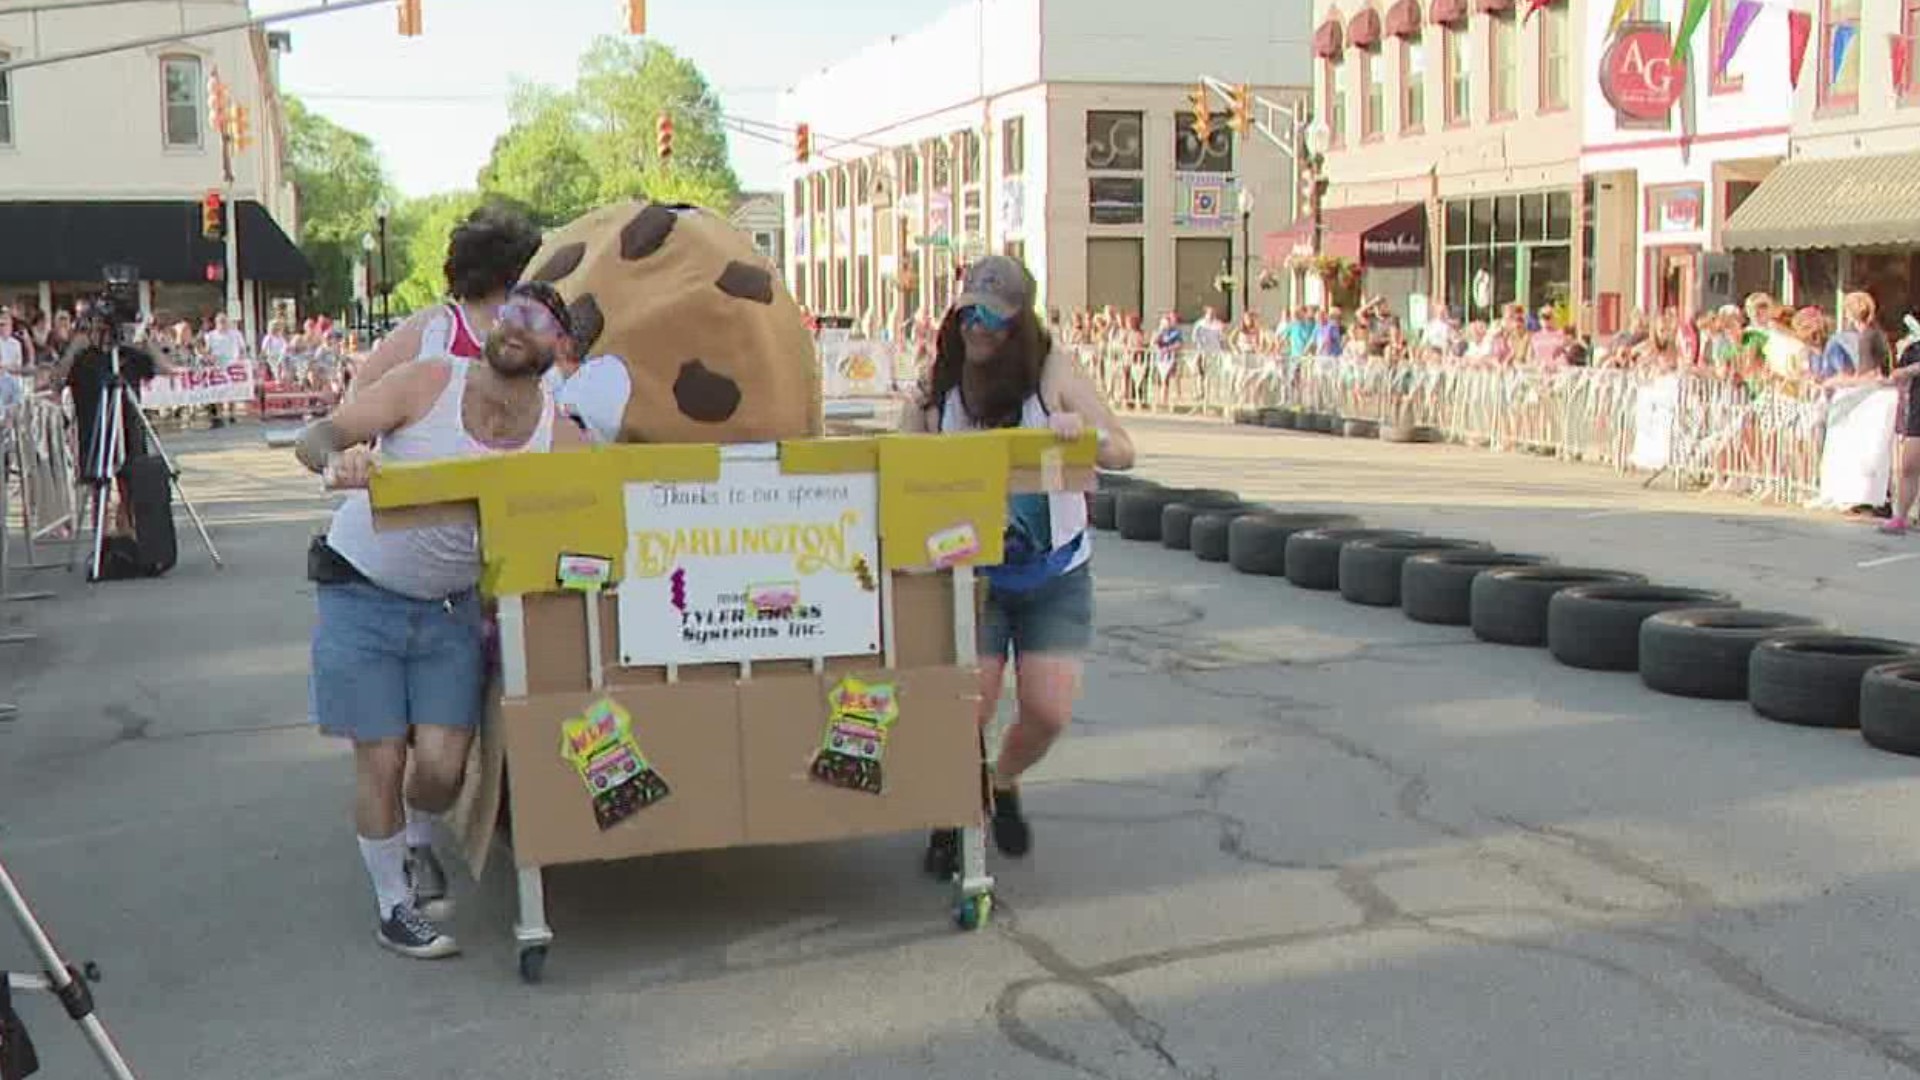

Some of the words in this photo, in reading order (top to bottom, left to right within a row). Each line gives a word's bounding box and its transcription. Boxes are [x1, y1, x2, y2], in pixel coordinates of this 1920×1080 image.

[1620, 39, 1673, 93] AG
[653, 479, 719, 506] Thanks
[729, 486, 745, 503] to
[752, 487, 779, 503] our
[634, 510, 858, 576] DARLINGTON
[682, 607, 745, 625] TYLER
[682, 626, 780, 644] Systems
